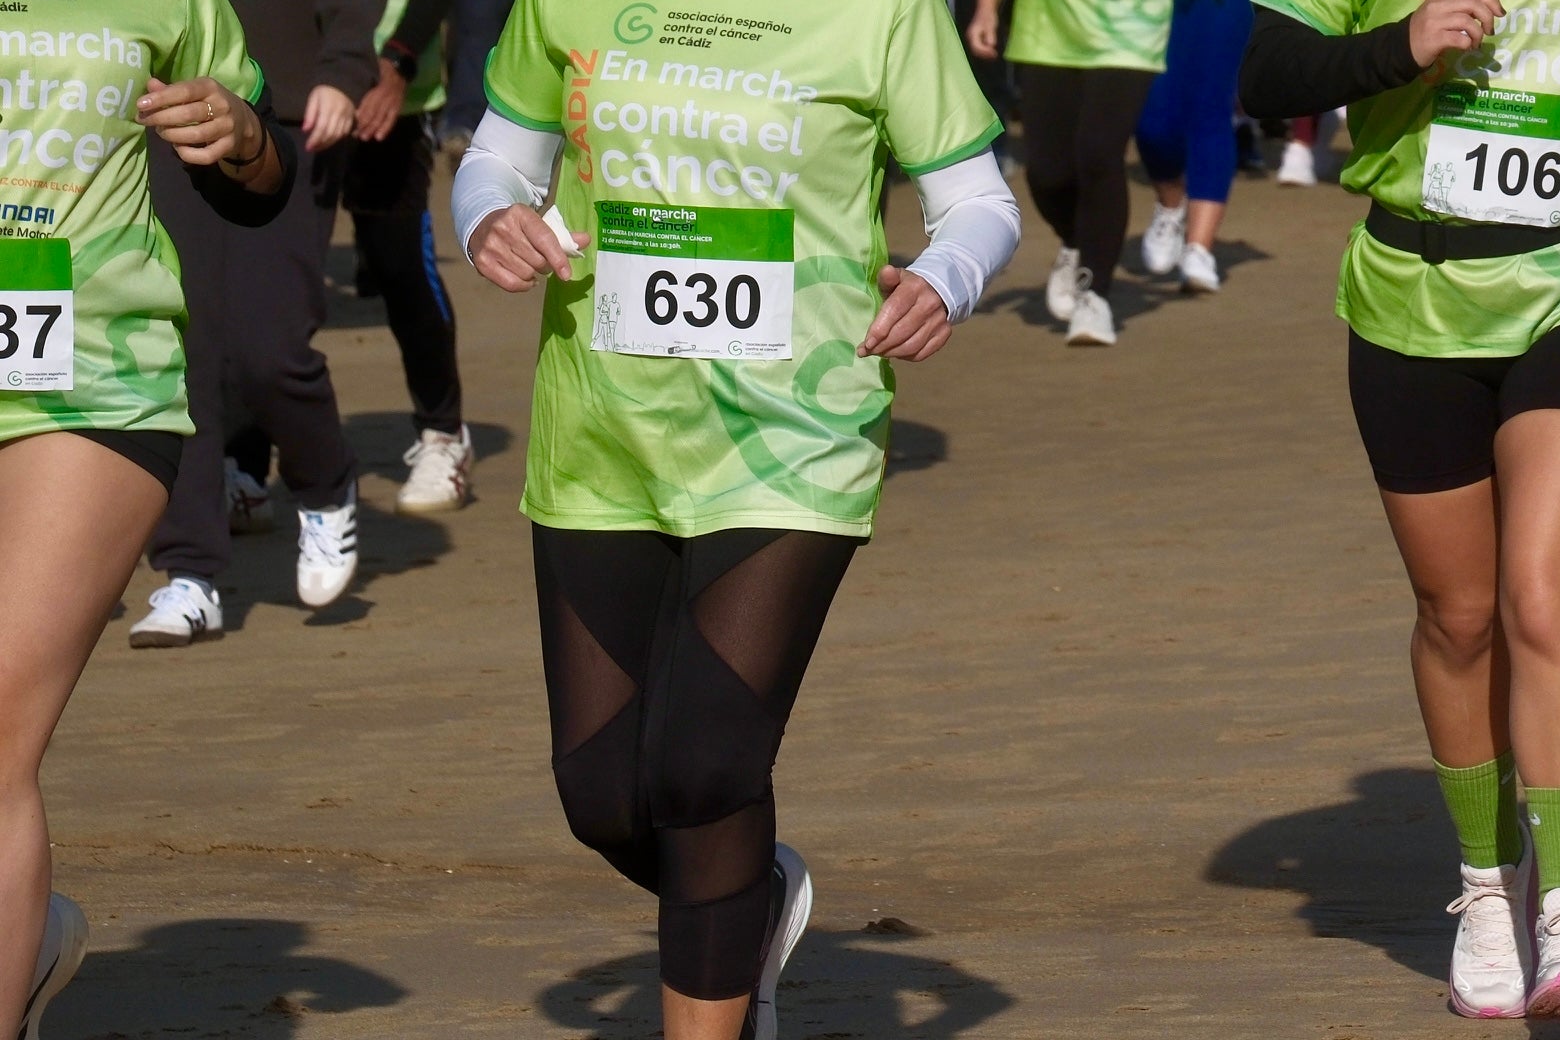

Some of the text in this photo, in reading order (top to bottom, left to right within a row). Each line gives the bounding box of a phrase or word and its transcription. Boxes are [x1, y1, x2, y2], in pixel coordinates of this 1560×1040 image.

[667, 10, 793, 35] asociación española
[663, 22, 763, 43] contra el cáncer
[659, 36, 713, 50] en Cádiz
[600, 49, 819, 107] En marcha
[95, 78, 135, 121] el
[1491, 90, 1536, 104] marcha
[1478, 98, 1490, 109] el
[1492, 100, 1535, 114] cáncer
[1497, 113, 1520, 121] CONTRA
[592, 99, 804, 157] contra el
[600, 138, 800, 204] cáncer
[11, 177, 49, 190] CONTRA
[50, 181, 61, 192] EL
[601, 202, 697, 221] Cádiz en marcha
[602, 216, 635, 228] contra
[636, 218, 649, 230] el
[634, 231, 657, 240] MARCHA
[656, 233, 681, 241] CONTRA
[649, 240, 659, 248] las
[644, 269, 762, 330] 630
